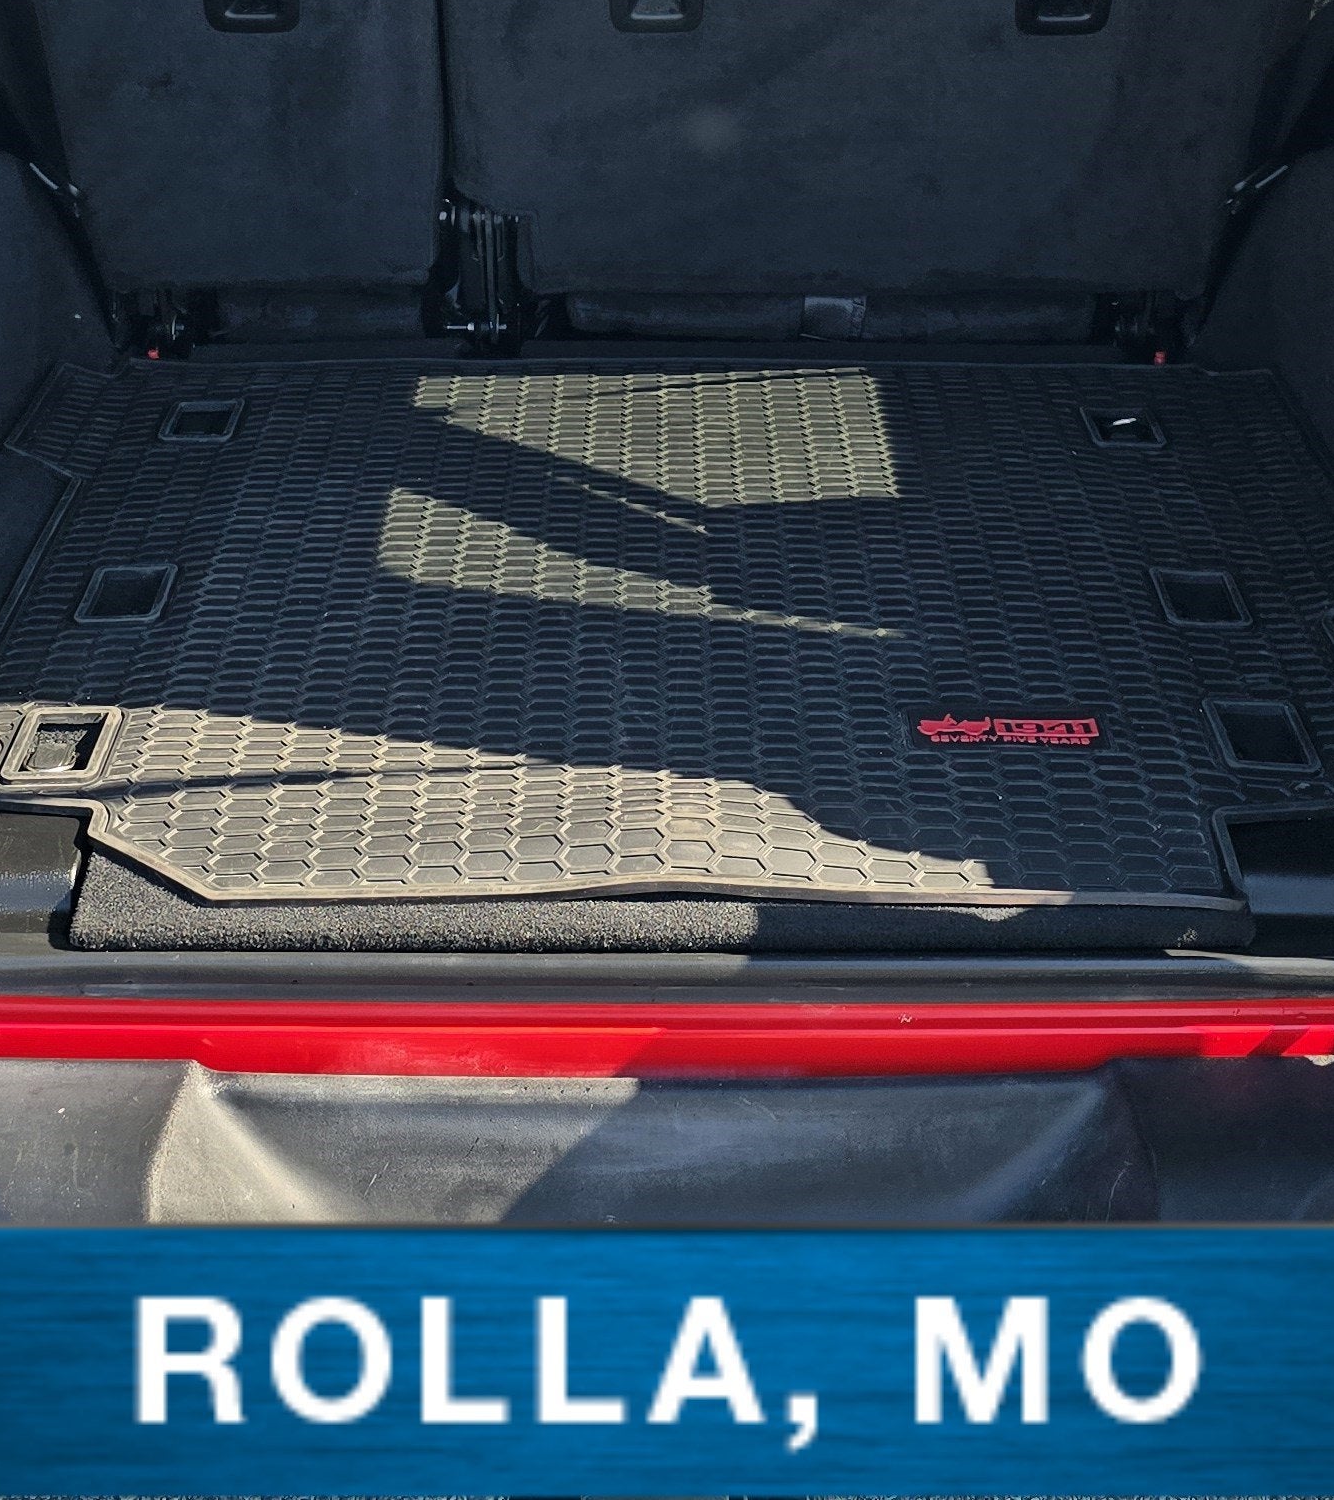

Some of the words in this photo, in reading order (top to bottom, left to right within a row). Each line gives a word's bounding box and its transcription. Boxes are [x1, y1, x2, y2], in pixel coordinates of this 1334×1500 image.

[1000, 720, 1096, 735] 1941
[930, 734, 999, 743] SEVENTY
[1003, 735, 1037, 744] FIVE
[1039, 736, 1091, 746] YEARS
